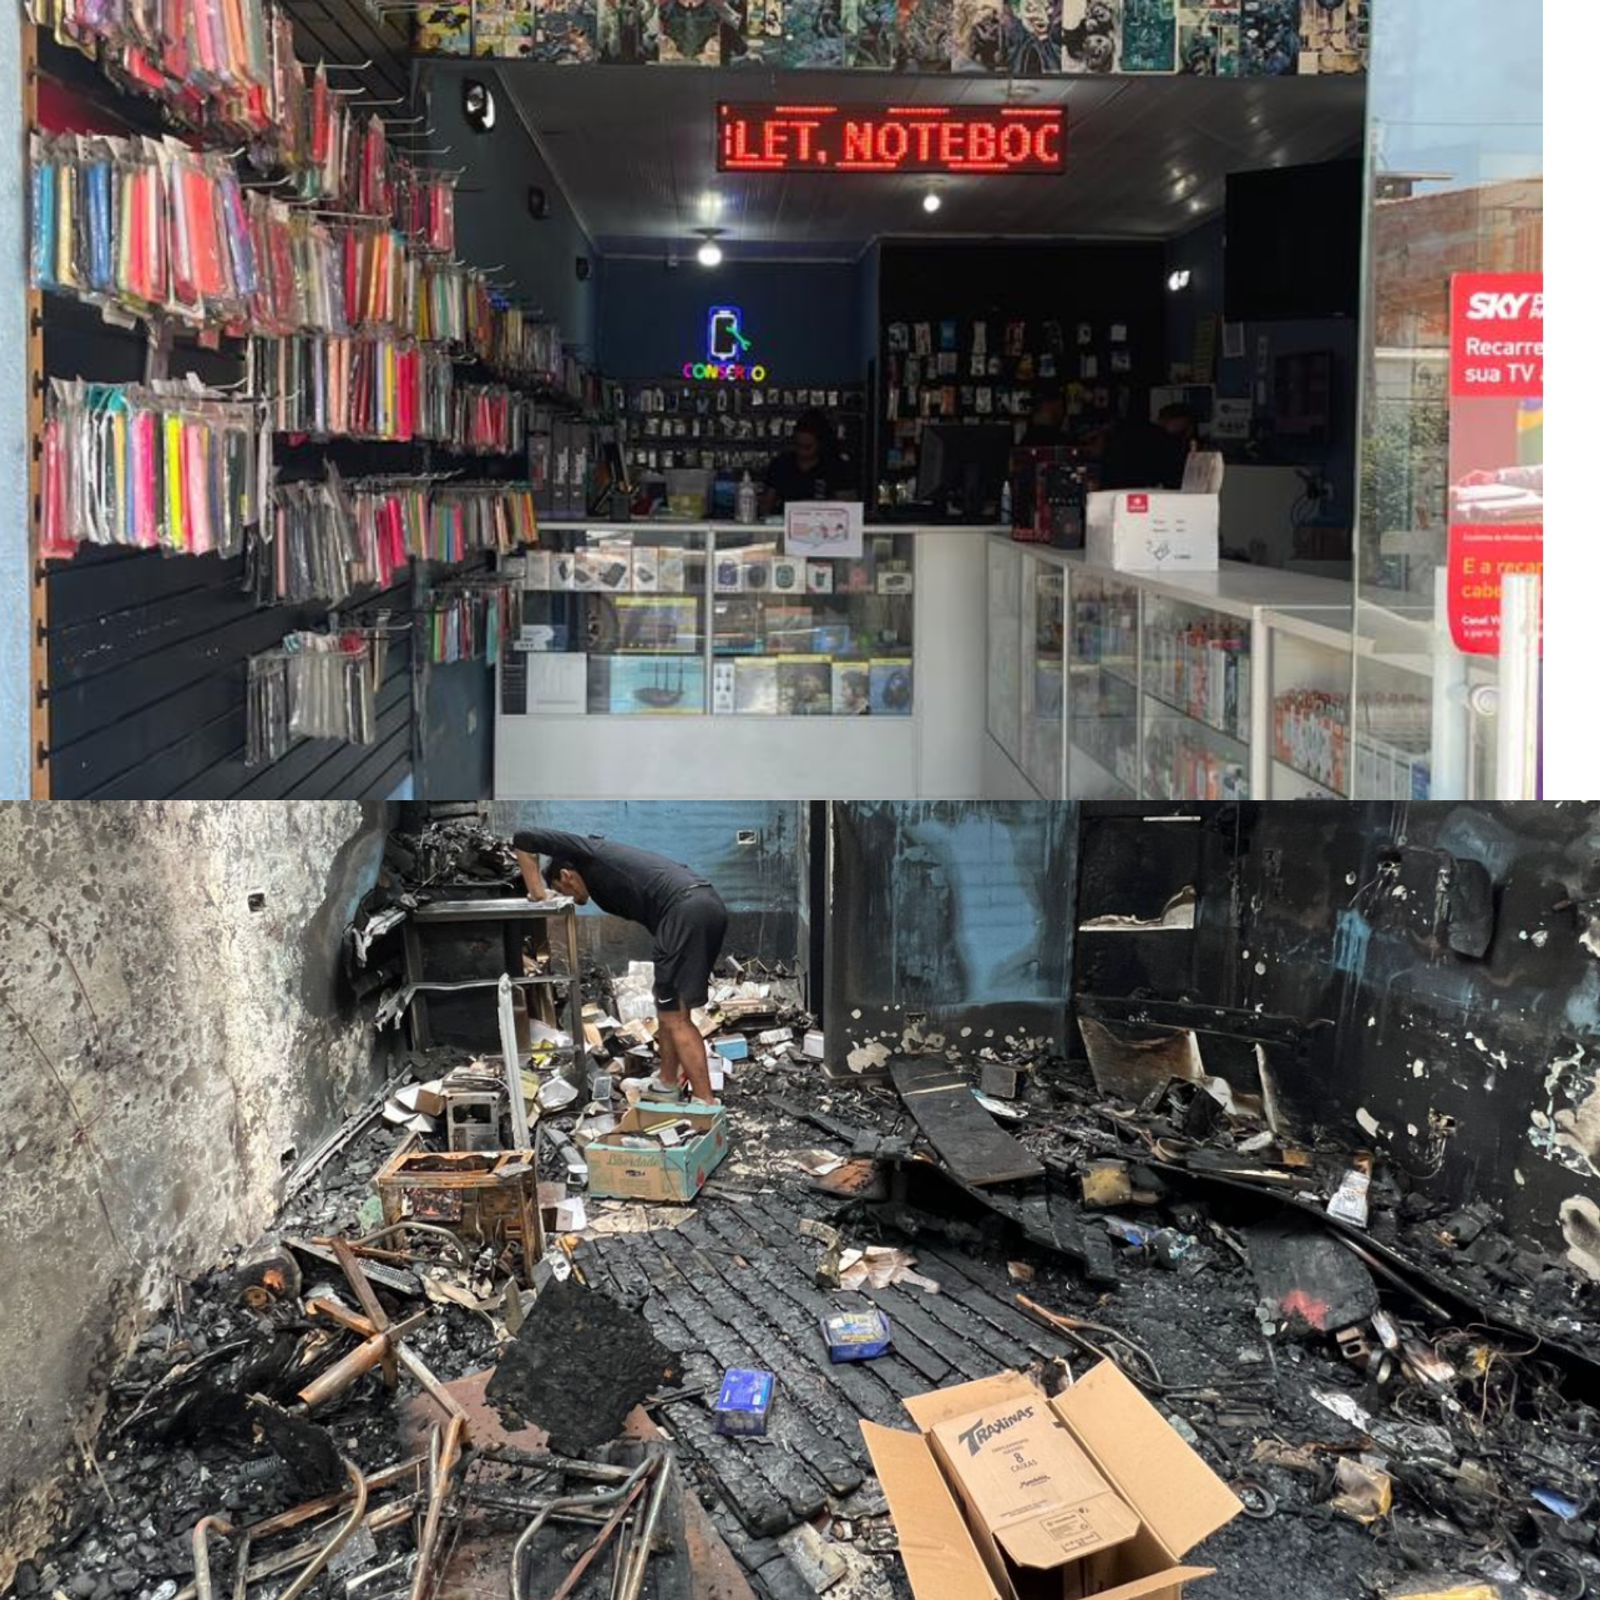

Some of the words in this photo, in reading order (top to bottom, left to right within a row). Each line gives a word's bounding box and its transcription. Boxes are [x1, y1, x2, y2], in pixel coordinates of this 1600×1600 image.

[1465, 292, 1528, 320] SKY
[1464, 367, 1501, 383] sua
[1507, 363, 1535, 382] TV
[1463, 557, 1475, 575] E
[1480, 561, 1491, 575] a
[1013, 1452, 1025, 1464] 8
